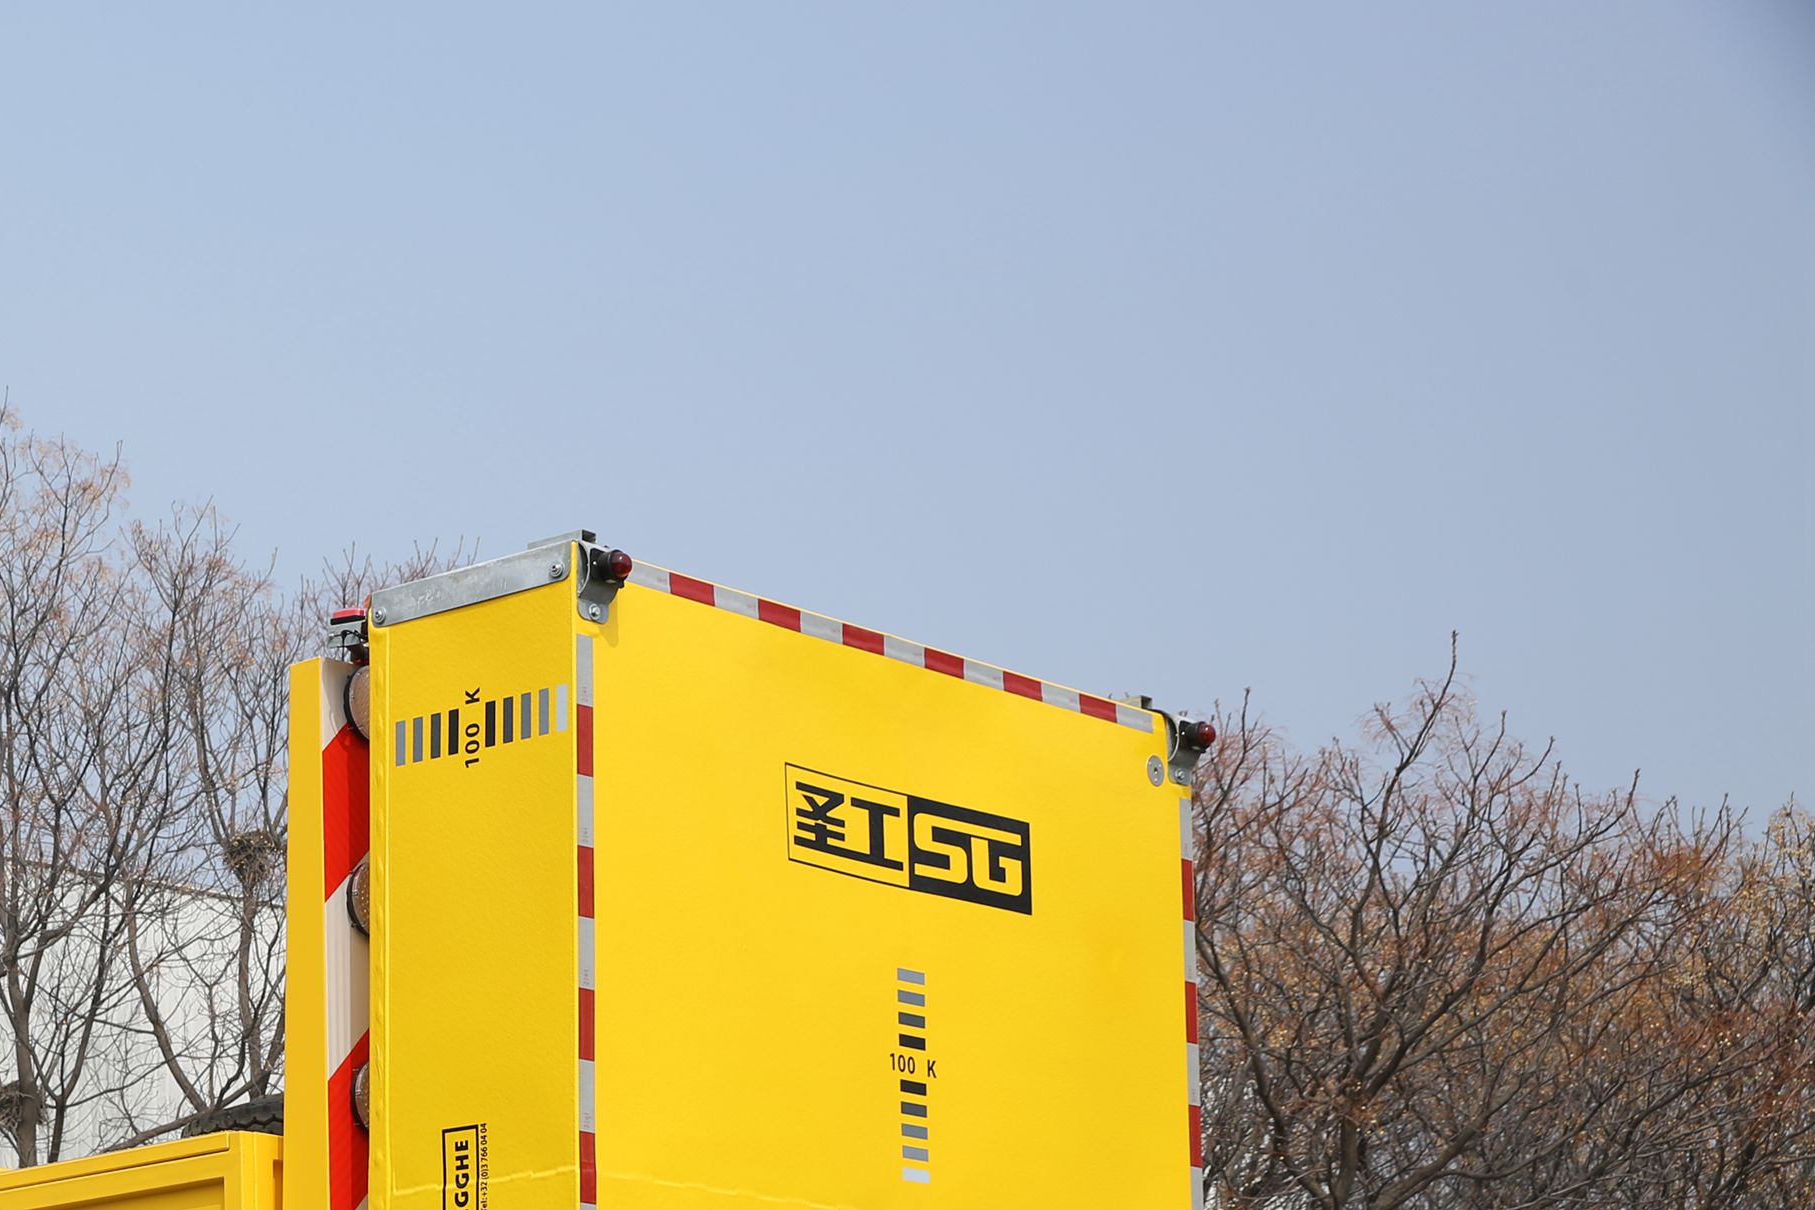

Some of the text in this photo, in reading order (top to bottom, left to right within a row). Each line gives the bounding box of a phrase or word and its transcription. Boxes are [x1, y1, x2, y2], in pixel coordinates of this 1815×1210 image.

[465, 687, 480, 768] 100 K
[890, 1053, 937, 1078] 100 K
